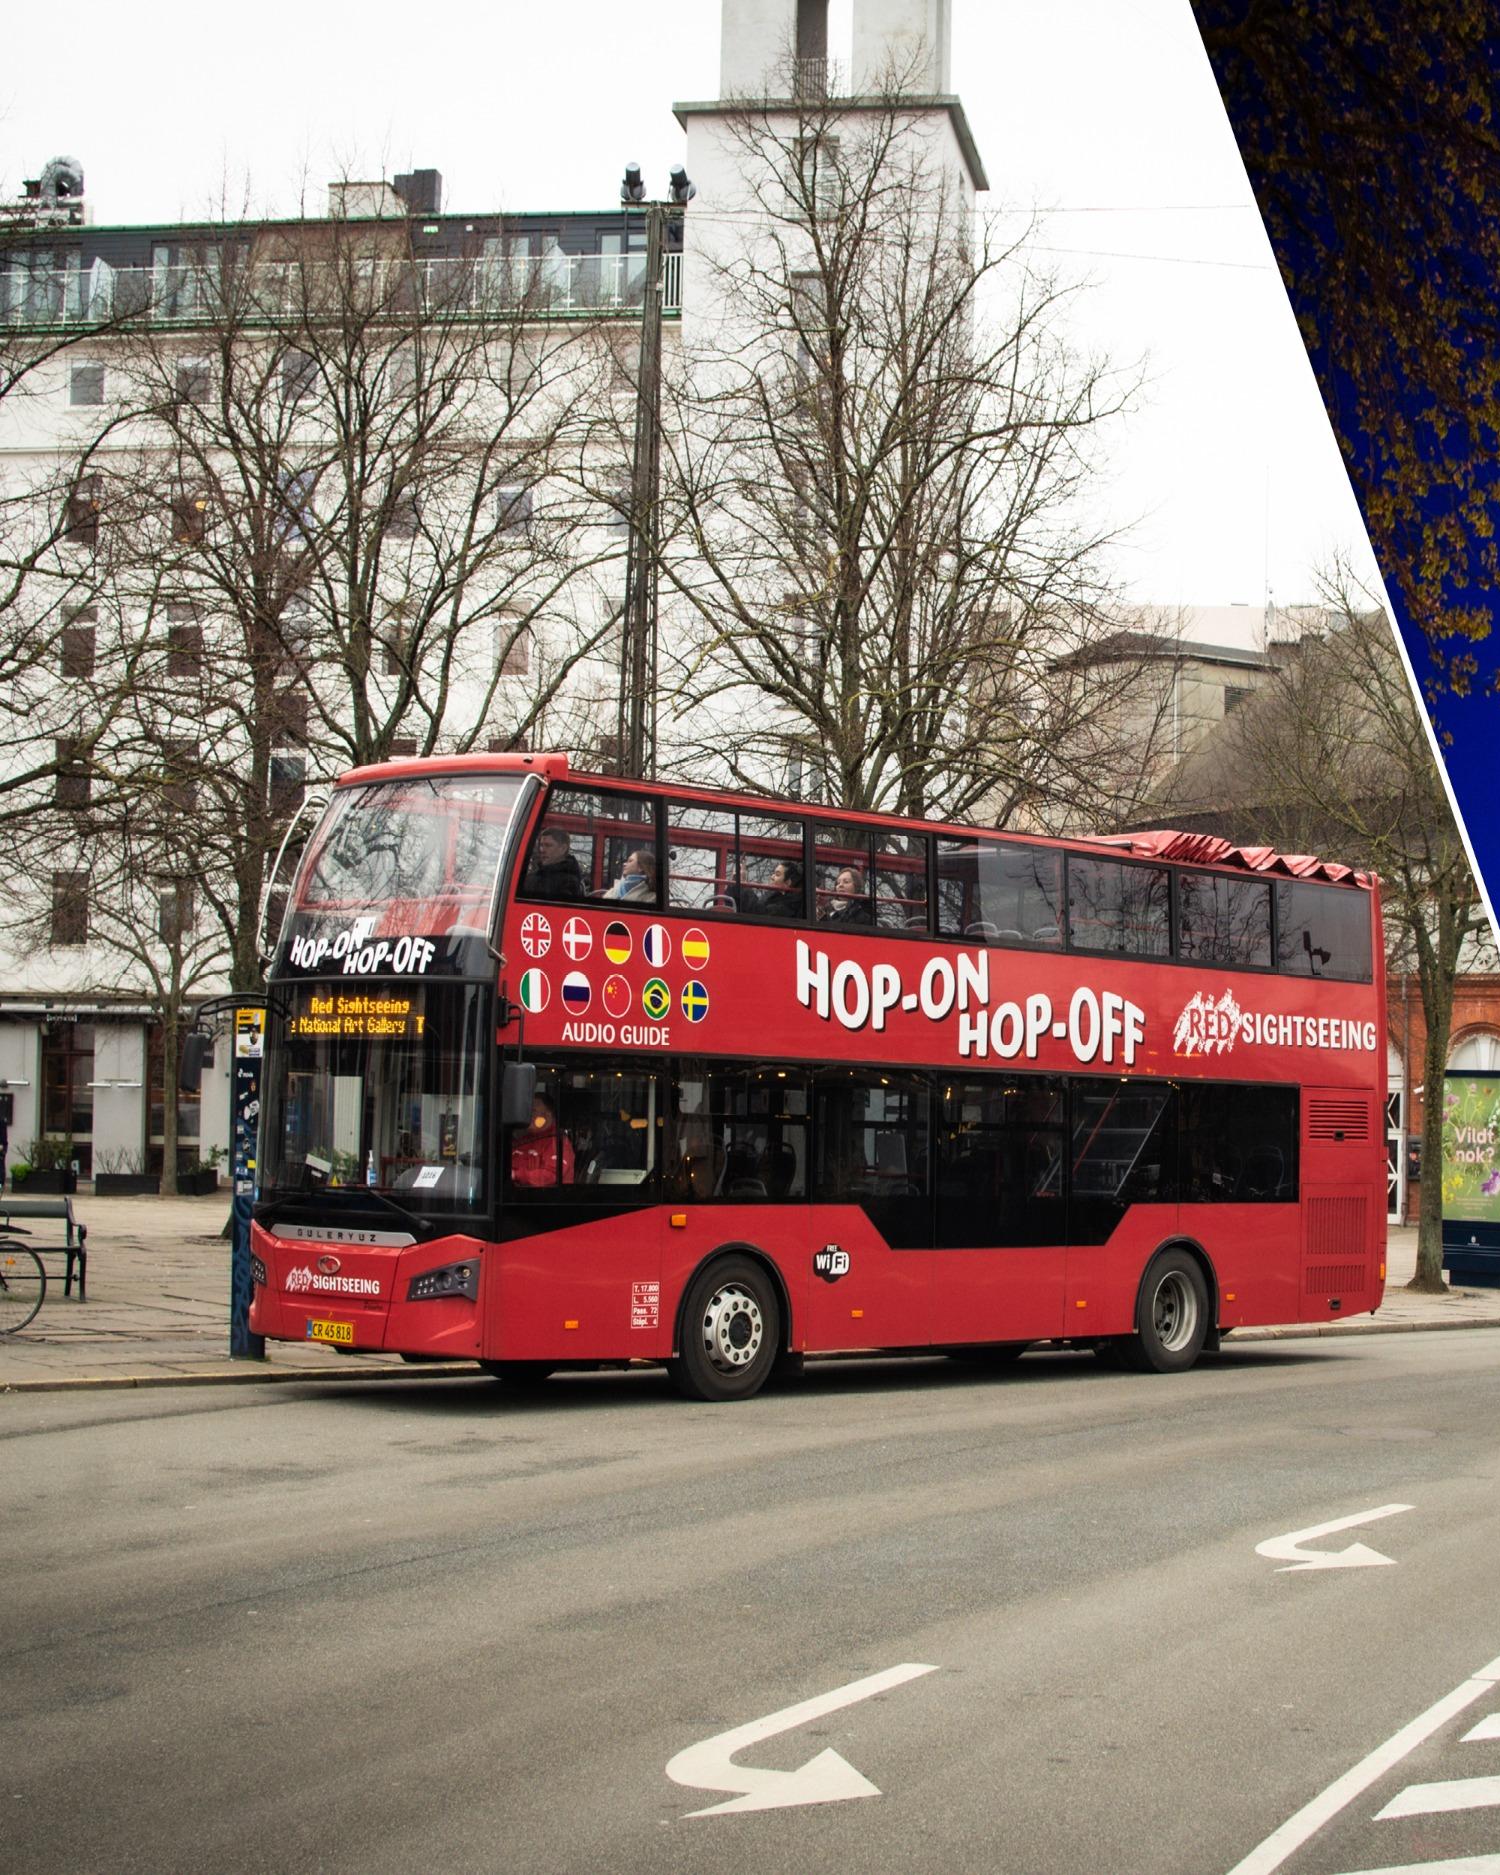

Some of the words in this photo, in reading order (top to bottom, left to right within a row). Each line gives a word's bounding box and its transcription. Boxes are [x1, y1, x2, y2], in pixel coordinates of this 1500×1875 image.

[290, 925, 371, 968] HOP-ON
[342, 936, 436, 974] HOP-OFF
[796, 939, 989, 1030] HOP-ON
[311, 997, 333, 1014] Red
[337, 997, 410, 1014] Sightseeing
[299, 1016, 341, 1034] National
[344, 1017, 363, 1033] Art
[367, 1017, 406, 1034] Gallery
[561, 1022, 616, 1043] AUDIO
[620, 1025, 670, 1046] GUIDE
[958, 987, 1145, 1065] HOP-OFF
[1241, 1012, 1377, 1052] SIGHTSEEING
[1455, 1126, 1495, 1144] Vildt
[1456, 1146, 1495, 1163] nok?
[297, 1228, 376, 1242] GULERYUZ
[313, 1274, 380, 1294] SIGHTSEEING
[312, 1323, 323, 1337] CR
[325, 1324, 335, 1338] 45
[336, 1325, 352, 1341] 818
